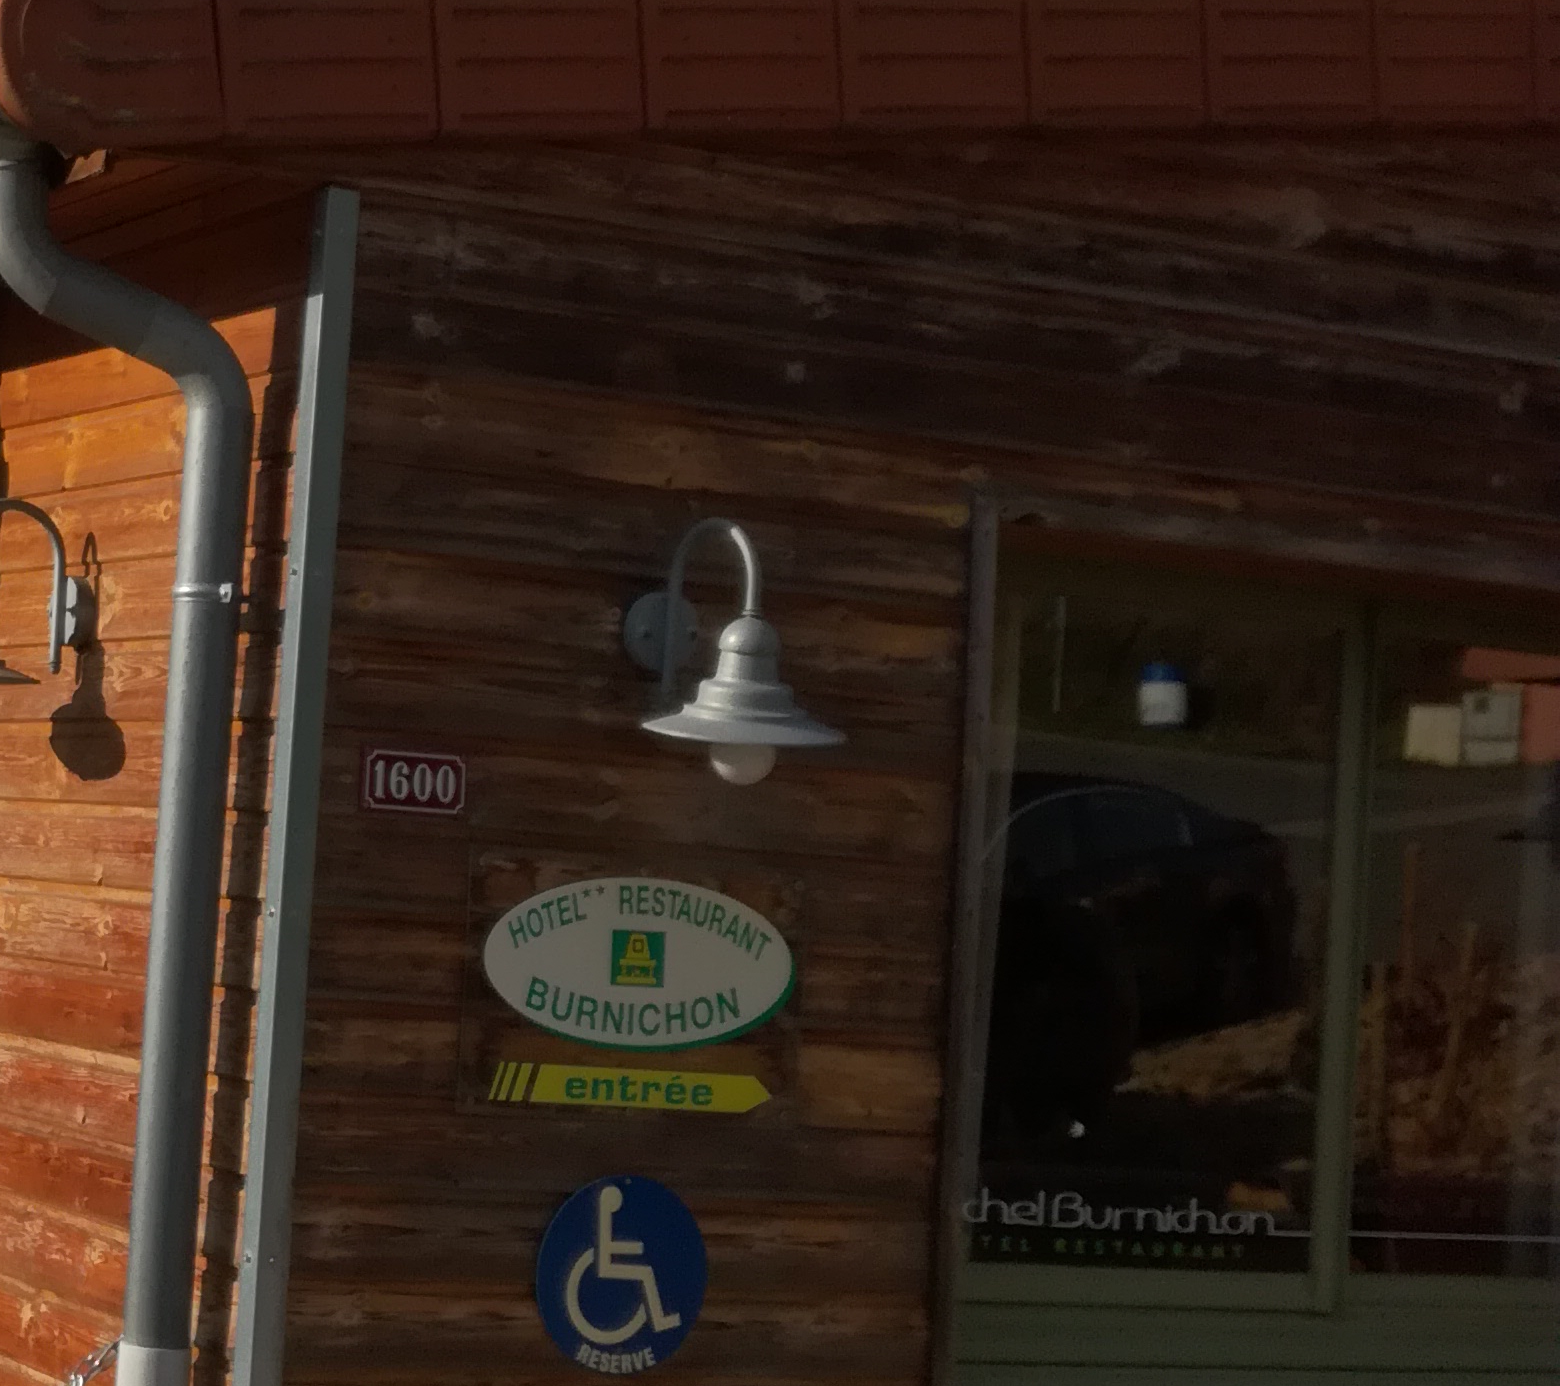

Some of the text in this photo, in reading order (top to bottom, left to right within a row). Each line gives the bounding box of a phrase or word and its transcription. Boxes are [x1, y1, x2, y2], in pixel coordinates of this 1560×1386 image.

[374, 759, 456, 804] 1600
[619, 884, 772, 961] RESTAURANT
[525, 976, 740, 1036] BURNICHON
[565, 1075, 714, 1106] entrée
